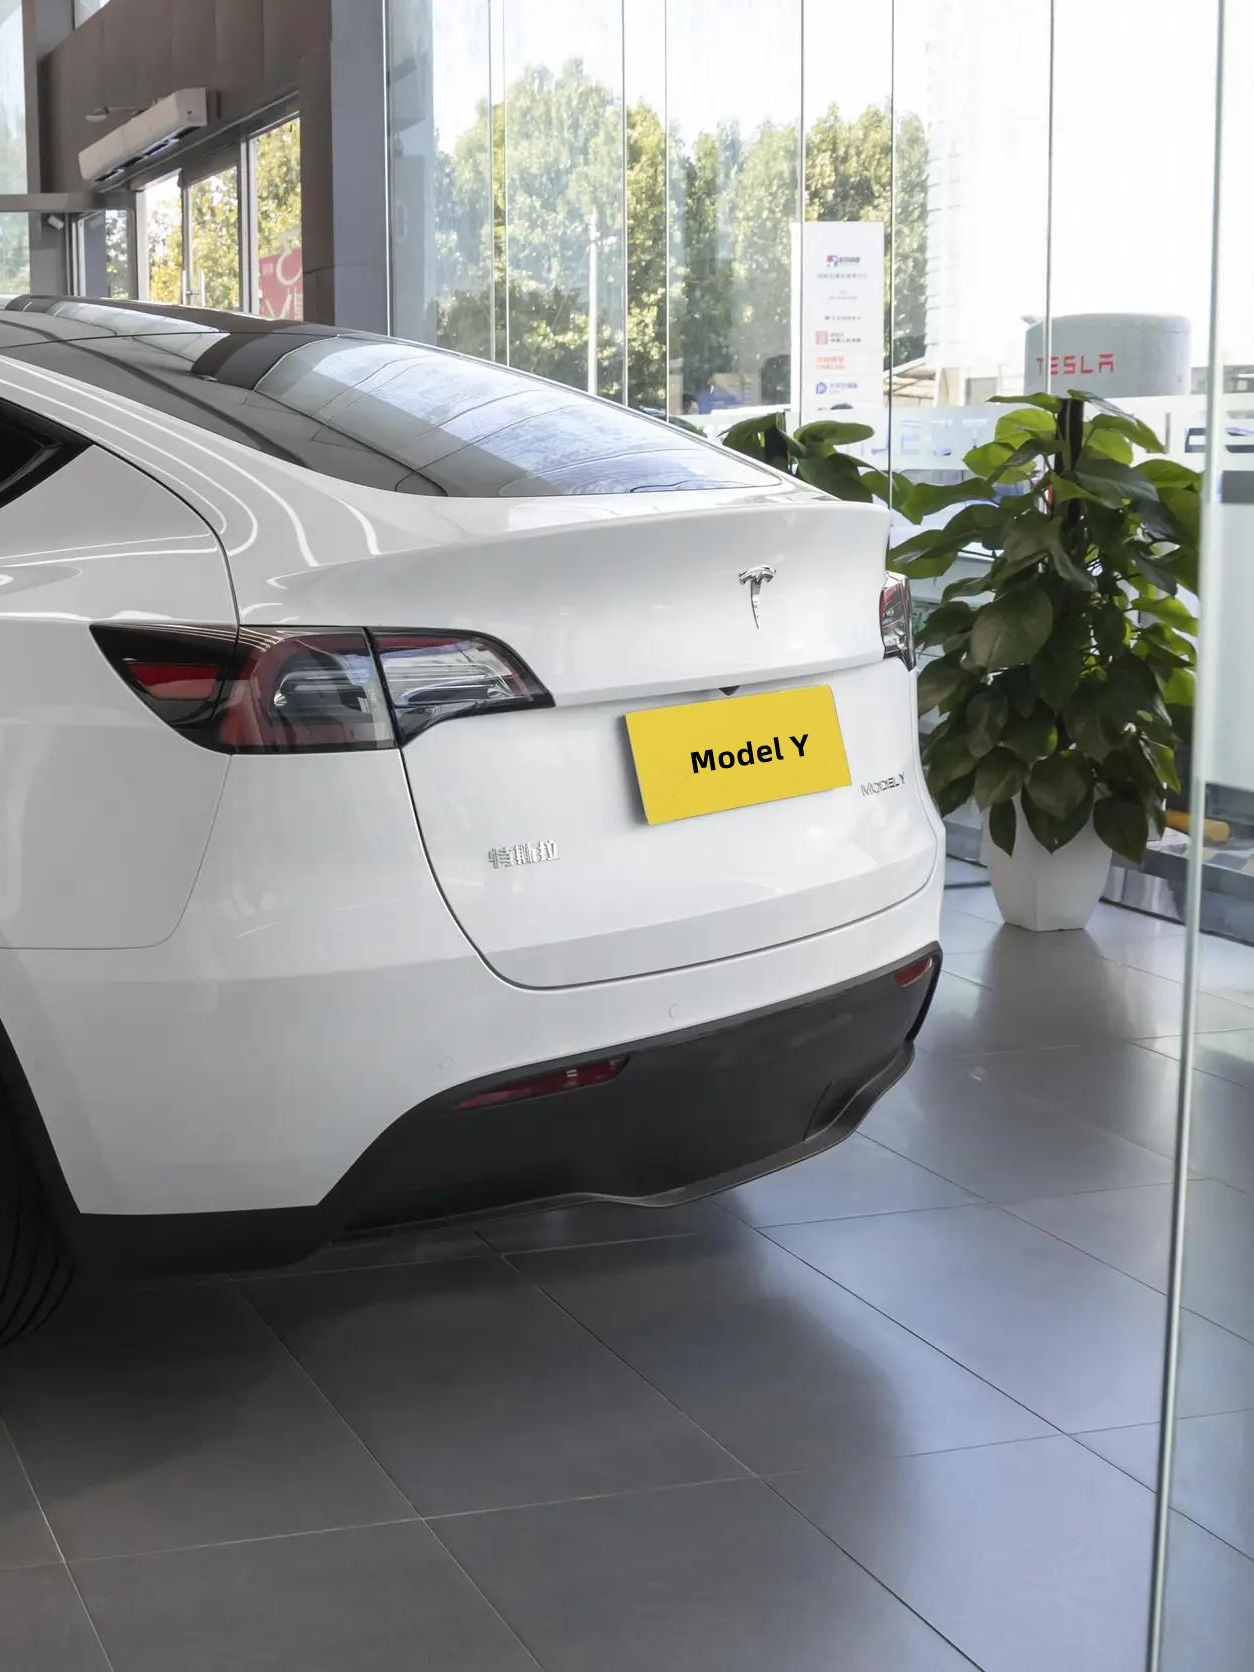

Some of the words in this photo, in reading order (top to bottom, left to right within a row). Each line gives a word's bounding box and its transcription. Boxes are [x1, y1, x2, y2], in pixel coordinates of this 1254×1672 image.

[1036, 353, 1114, 376] TESLA
[690, 736, 785, 774] Model
[789, 733, 809, 757] Y
